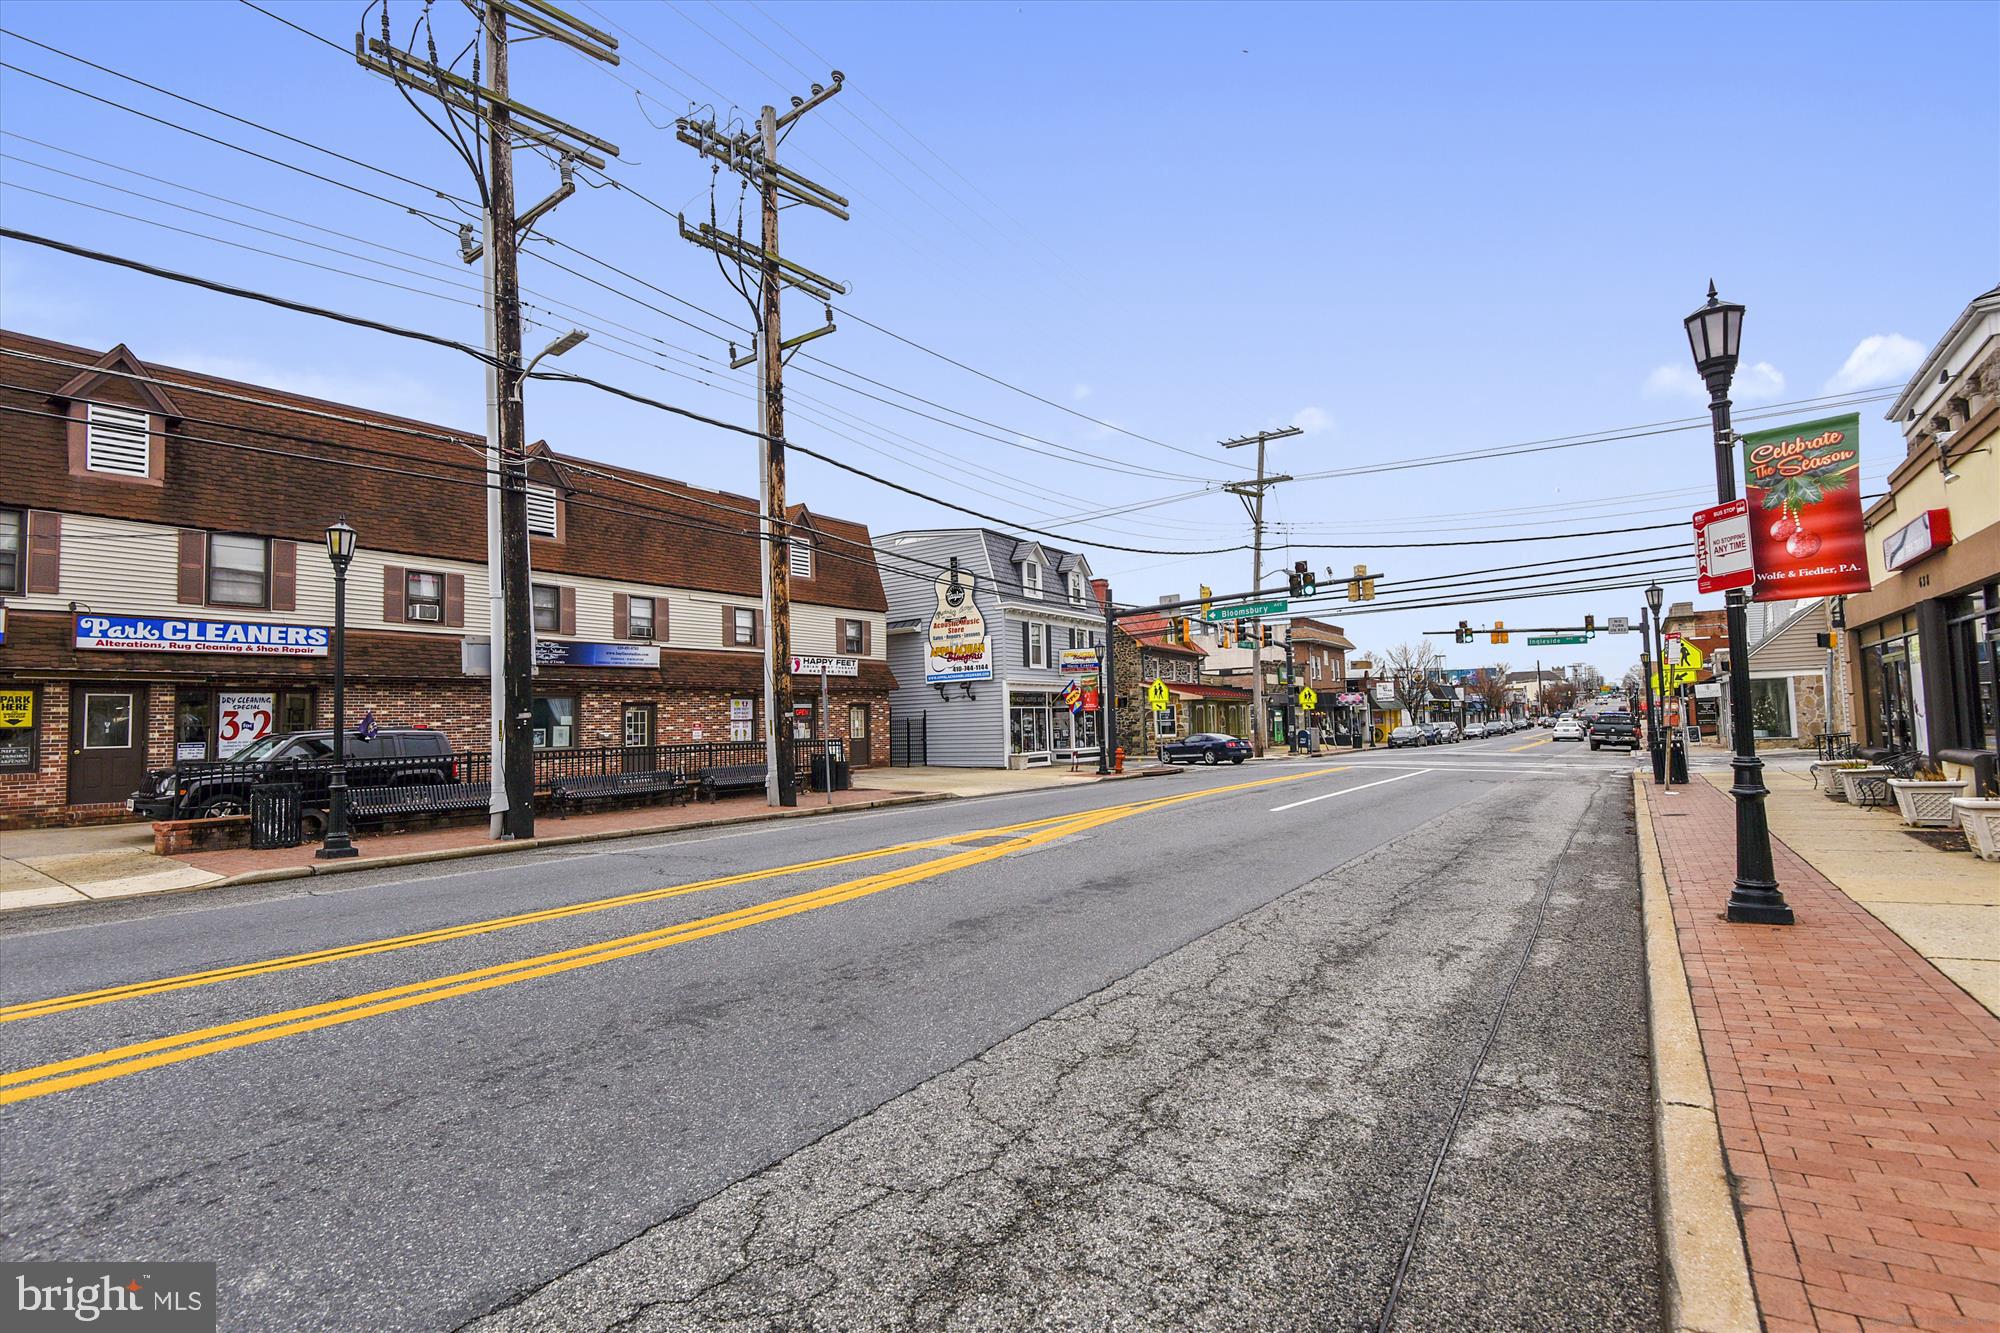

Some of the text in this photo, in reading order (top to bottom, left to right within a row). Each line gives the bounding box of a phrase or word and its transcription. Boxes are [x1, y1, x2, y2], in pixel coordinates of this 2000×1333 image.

[1750, 432, 1843, 465] Celebrate
[1750, 450, 1856, 479] The Season
[1724, 506, 1736, 514] STOP
[1721, 533, 1745, 544] STOPPING
[1714, 540, 1746, 554] ANY TIME
[1757, 572, 1785, 581] Wolfe
[1799, 567, 1837, 577] Fiedler,
[1840, 564, 1861, 572] P.A.
[1222, 606, 1268, 618] Bloomsbury
[934, 620, 960, 629] Acoustic
[80, 618, 327, 645] Park CLEANERS
[95, 639, 165, 649] Alterations,
[169, 642, 191, 651] Rug
[195, 643, 242, 652] Cleaning
[930, 643, 985, 657] APPALACHIAN
[945, 652, 982, 663] Bluegrass
[952, 664, 988, 672] 410-744-1144
[1066, 692, 1080, 703] OPEN
[220, 711, 240, 740] 3
[253, 710, 272, 740] 2
